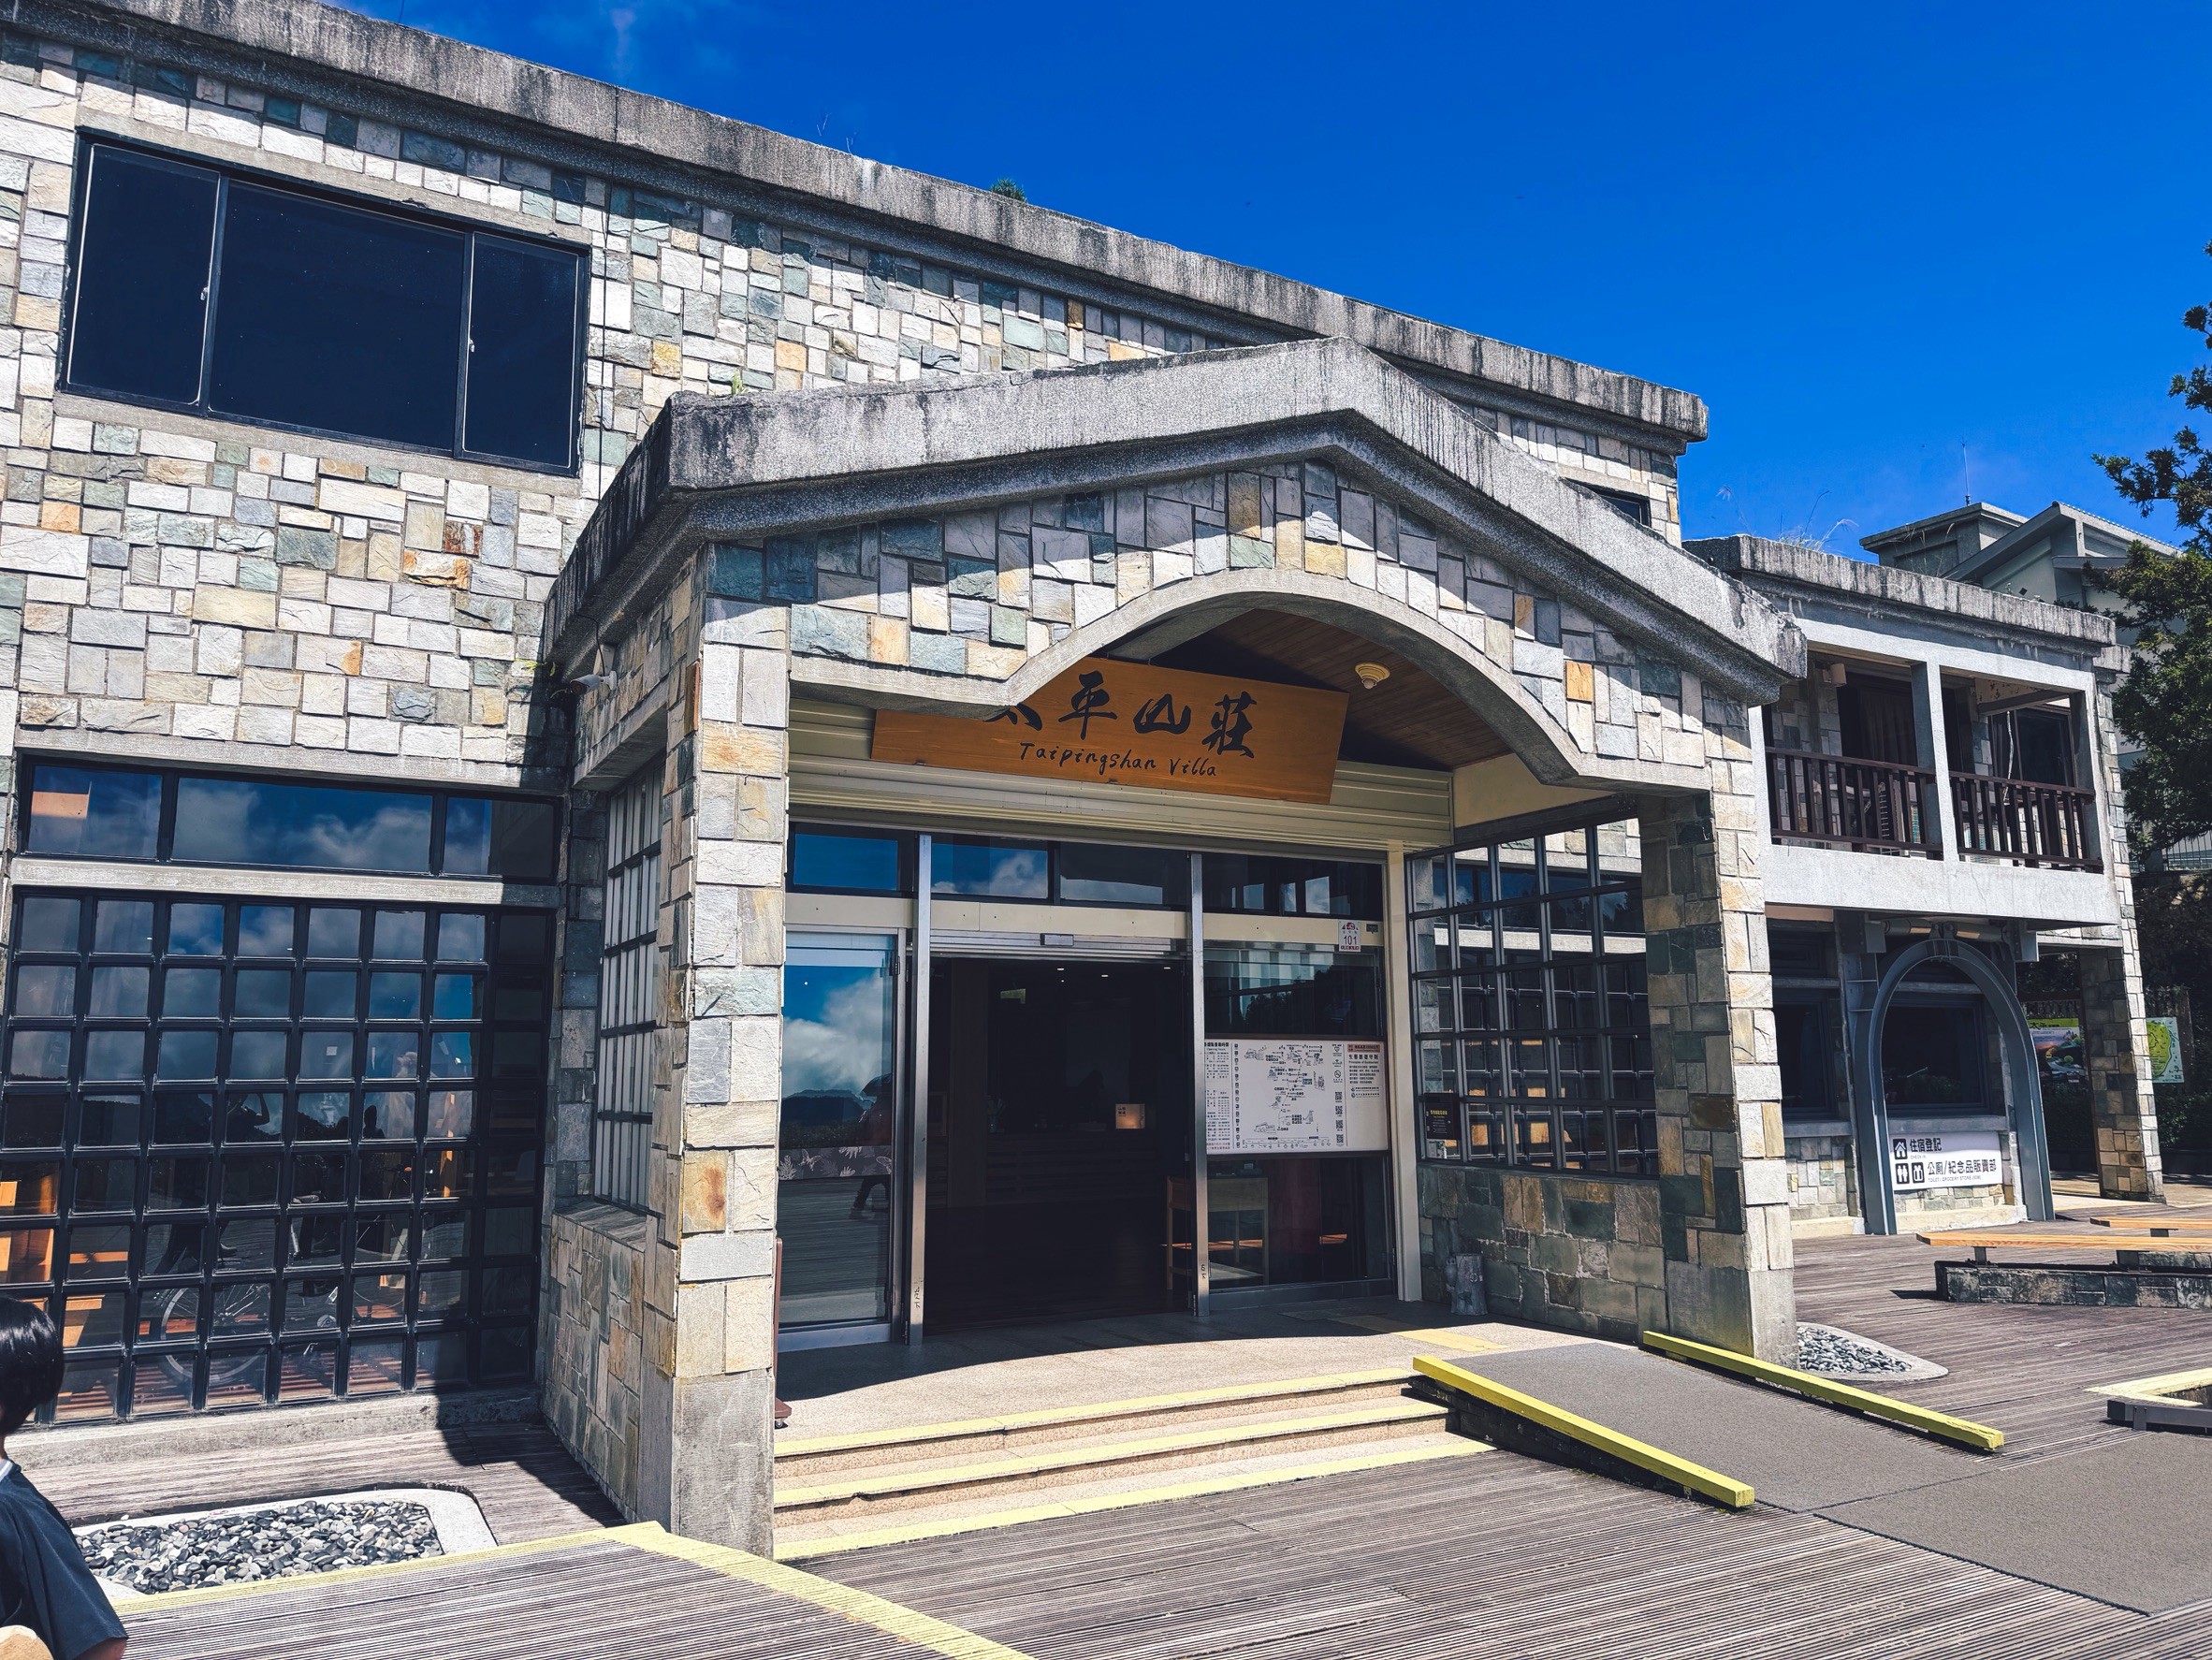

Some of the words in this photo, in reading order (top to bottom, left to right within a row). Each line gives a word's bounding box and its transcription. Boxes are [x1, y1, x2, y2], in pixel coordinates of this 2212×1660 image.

[1020, 742, 1156, 775] Taipingshan
[1170, 758, 1216, 777] Villa
[1344, 936, 1357, 945] 101
[1910, 1138, 1942, 1152] 住宿登記
